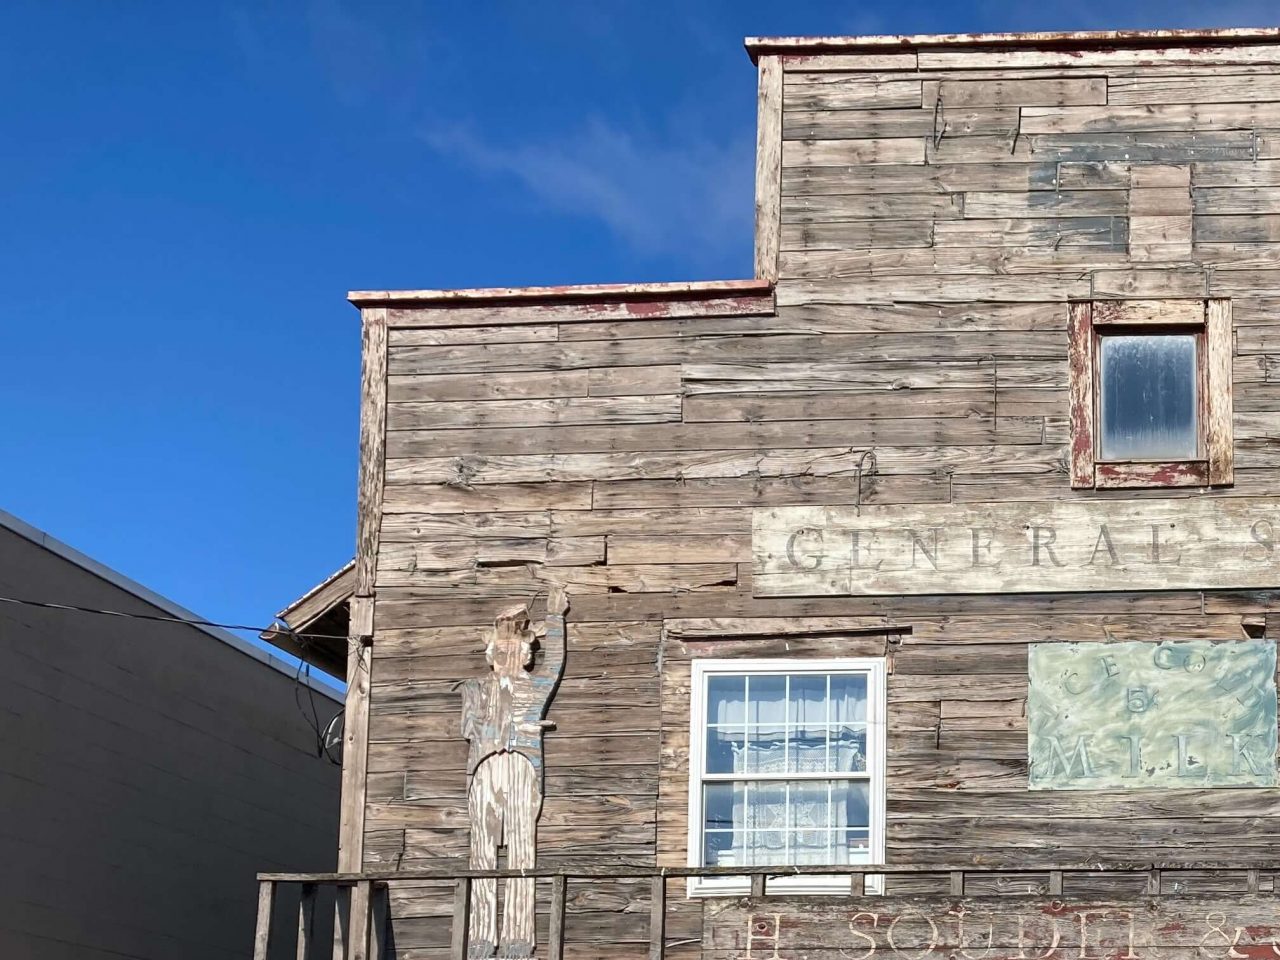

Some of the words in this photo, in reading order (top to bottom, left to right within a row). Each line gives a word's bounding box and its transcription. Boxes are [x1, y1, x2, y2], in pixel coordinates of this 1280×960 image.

[785, 522, 1183, 572] GENERAL
[1036, 733, 1272, 778] MILK
[1199, 910, 1250, 959] &
